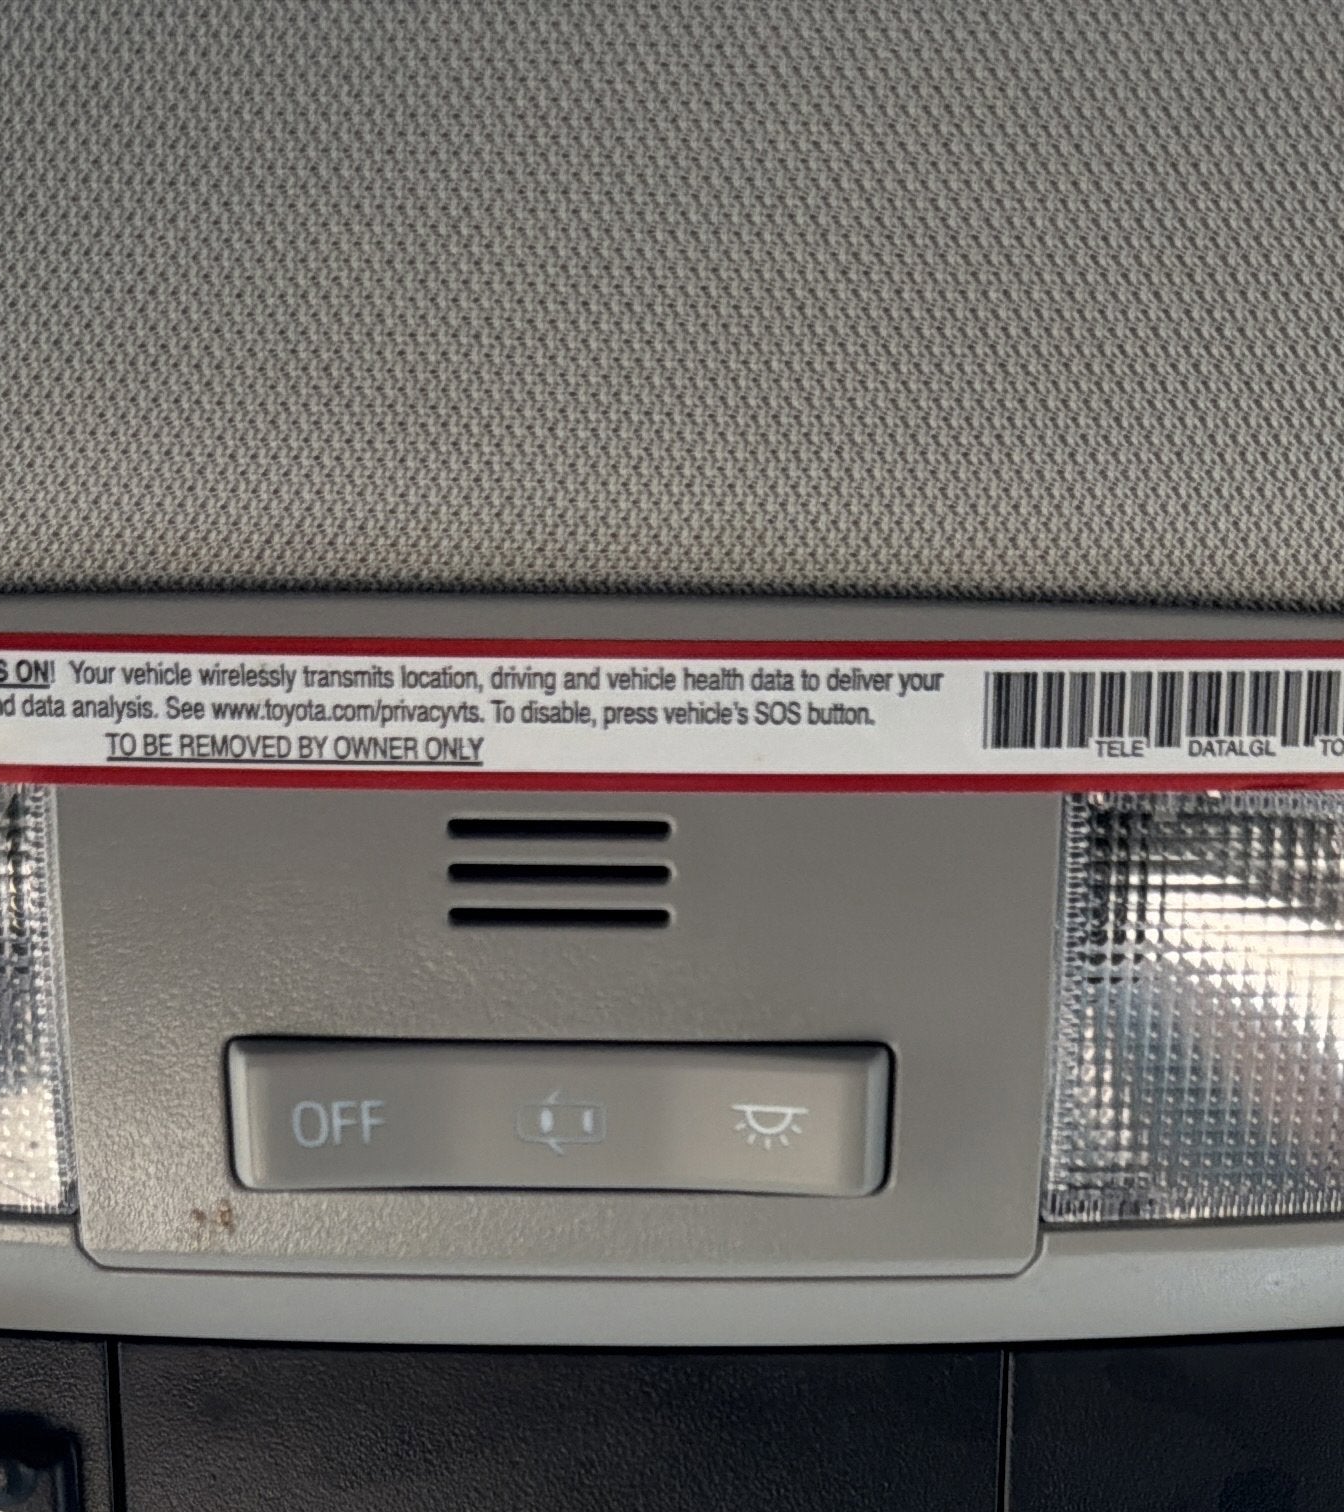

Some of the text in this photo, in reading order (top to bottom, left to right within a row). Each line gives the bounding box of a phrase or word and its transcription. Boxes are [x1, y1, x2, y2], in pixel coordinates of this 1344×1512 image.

[15, 660, 56, 685] ON!
[69, 661, 116, 684] Your
[121, 663, 192, 685] vehicle
[198, 664, 296, 692] wirelessly
[302, 666, 394, 689] transmits
[401, 666, 484, 692] location,
[491, 667, 556, 695] driving
[563, 667, 600, 689] and
[608, 668, 675, 691] vehicle
[683, 668, 744, 691] health
[751, 669, 794, 691] data
[801, 670, 820, 691] to
[827, 669, 893, 691] deliver
[898, 673, 943, 697] your
[22, 697, 65, 717] data
[72, 696, 159, 721] analysis.
[166, 698, 205, 718] See
[212, 699, 484, 727] www.toyota.com/privacyvts.
[491, 702, 514, 723] To
[521, 702, 597, 727] disable,
[603, 707, 657, 729] press
[664, 702, 748, 725] vehicle's
[756, 702, 801, 724] SOS
[808, 703, 875, 726] button.
[106, 733, 483, 761] TO BE REMOVED BY OWNER ONLY
[1096, 740, 1144, 757] TELE
[1188, 740, 1276, 758] DATALGL
[291, 1101, 387, 1149] OFF
